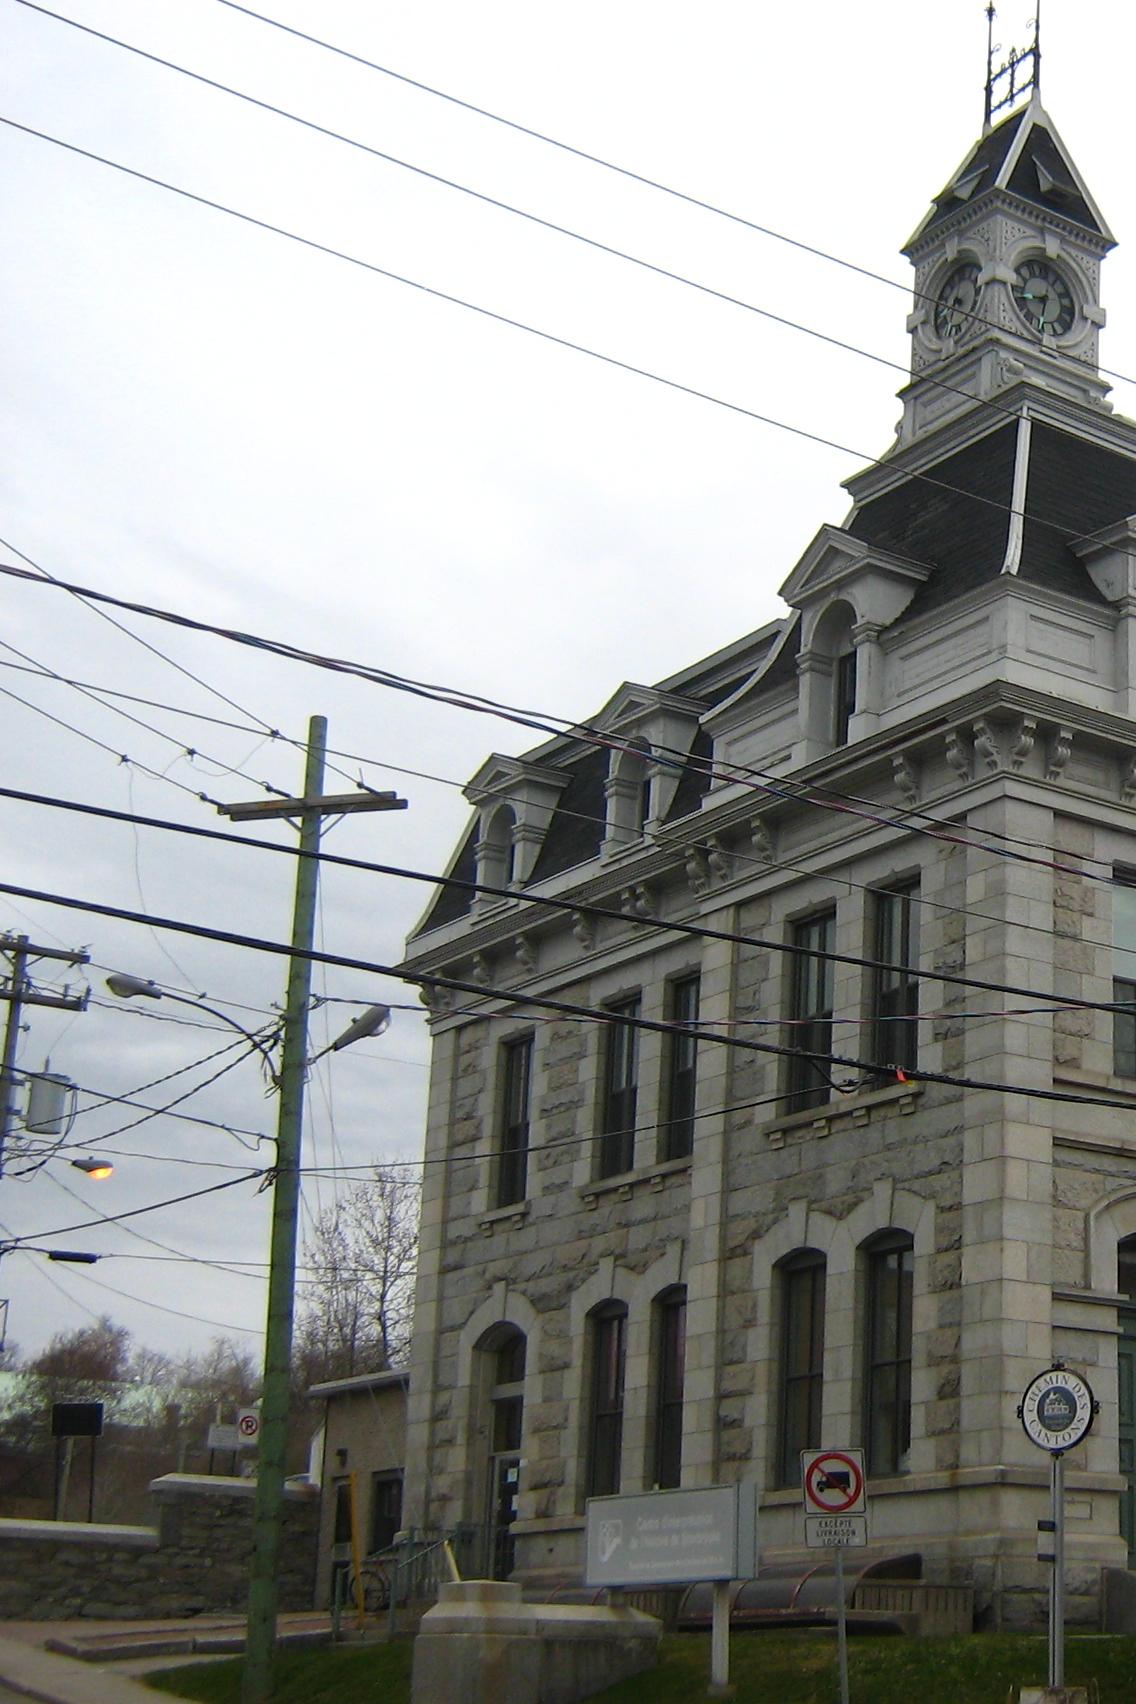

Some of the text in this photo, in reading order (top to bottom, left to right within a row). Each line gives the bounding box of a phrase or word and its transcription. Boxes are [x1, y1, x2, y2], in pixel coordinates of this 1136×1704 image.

[1028, 1374, 1088, 1412] CHEMIN DES
[1028, 1416, 1085, 1445] CANTONS
[815, 1528, 857, 1537] LIVRAISON
[822, 1537, 851, 1546] LOCALE
